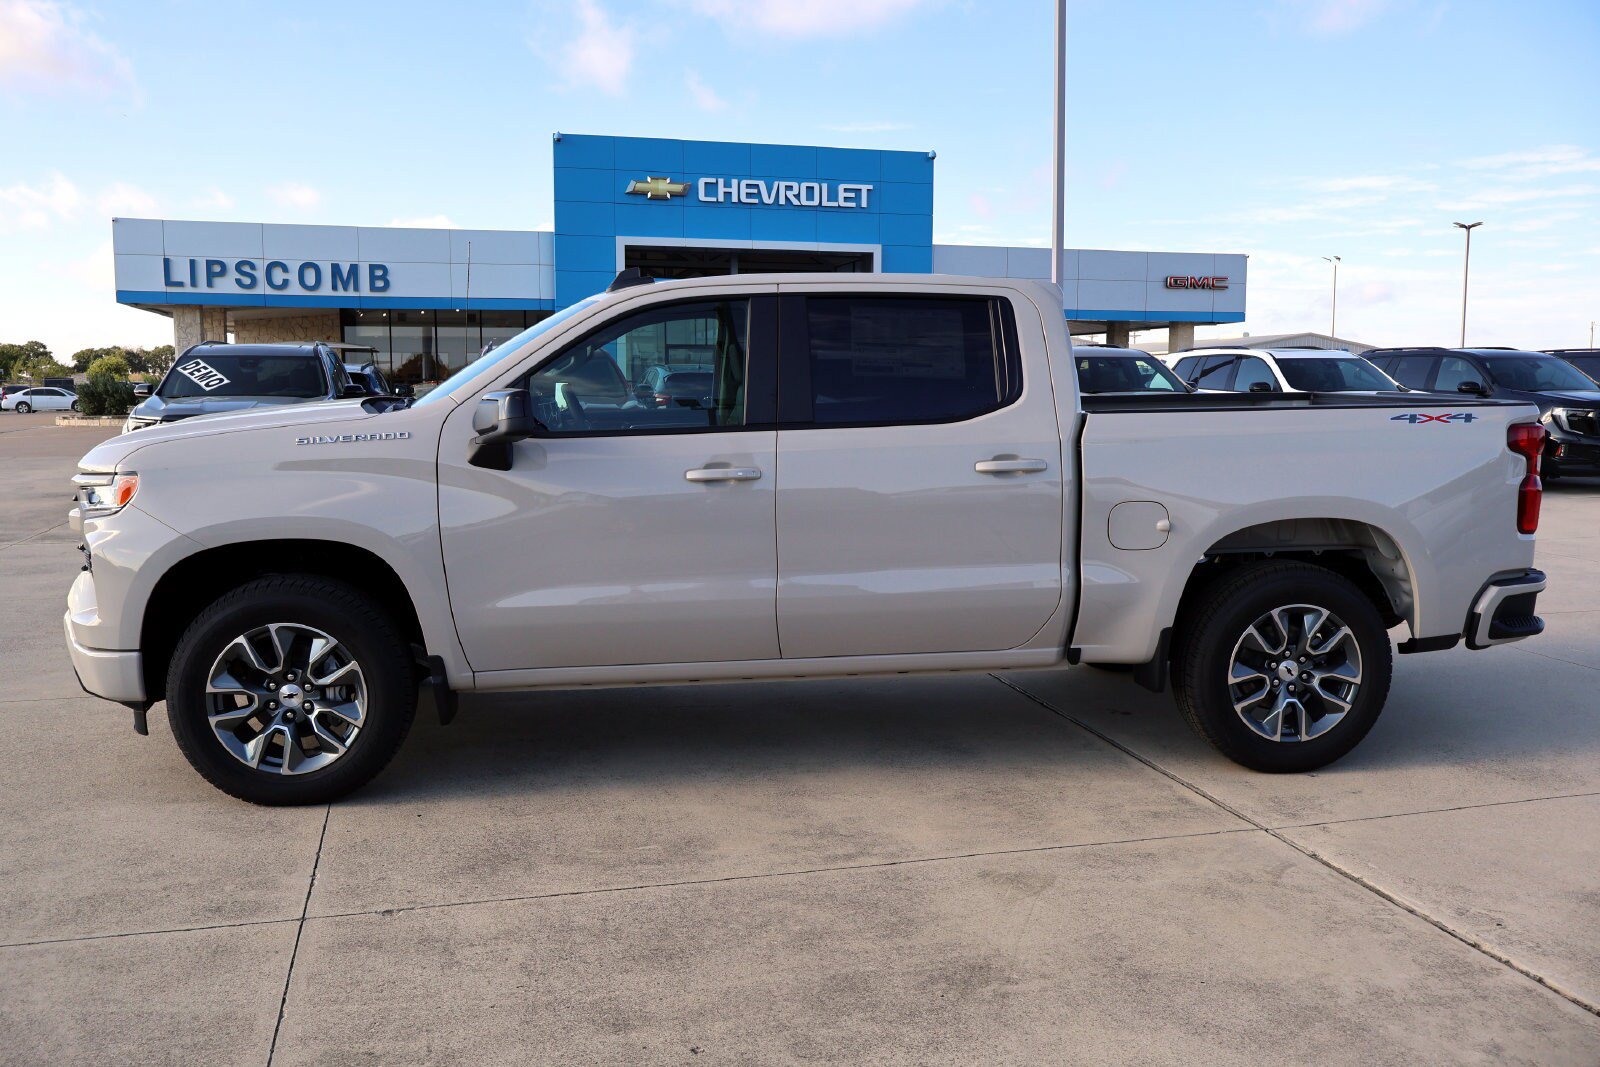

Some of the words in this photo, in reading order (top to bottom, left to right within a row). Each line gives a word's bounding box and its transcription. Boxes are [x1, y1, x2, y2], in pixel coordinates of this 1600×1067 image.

[698, 177, 873, 208] CHEVROLET
[163, 257, 391, 292] LIPSCOMB
[1165, 275, 1229, 290] GMC
[181, 360, 225, 388] DEMO
[295, 431, 411, 445] SILVERADO
